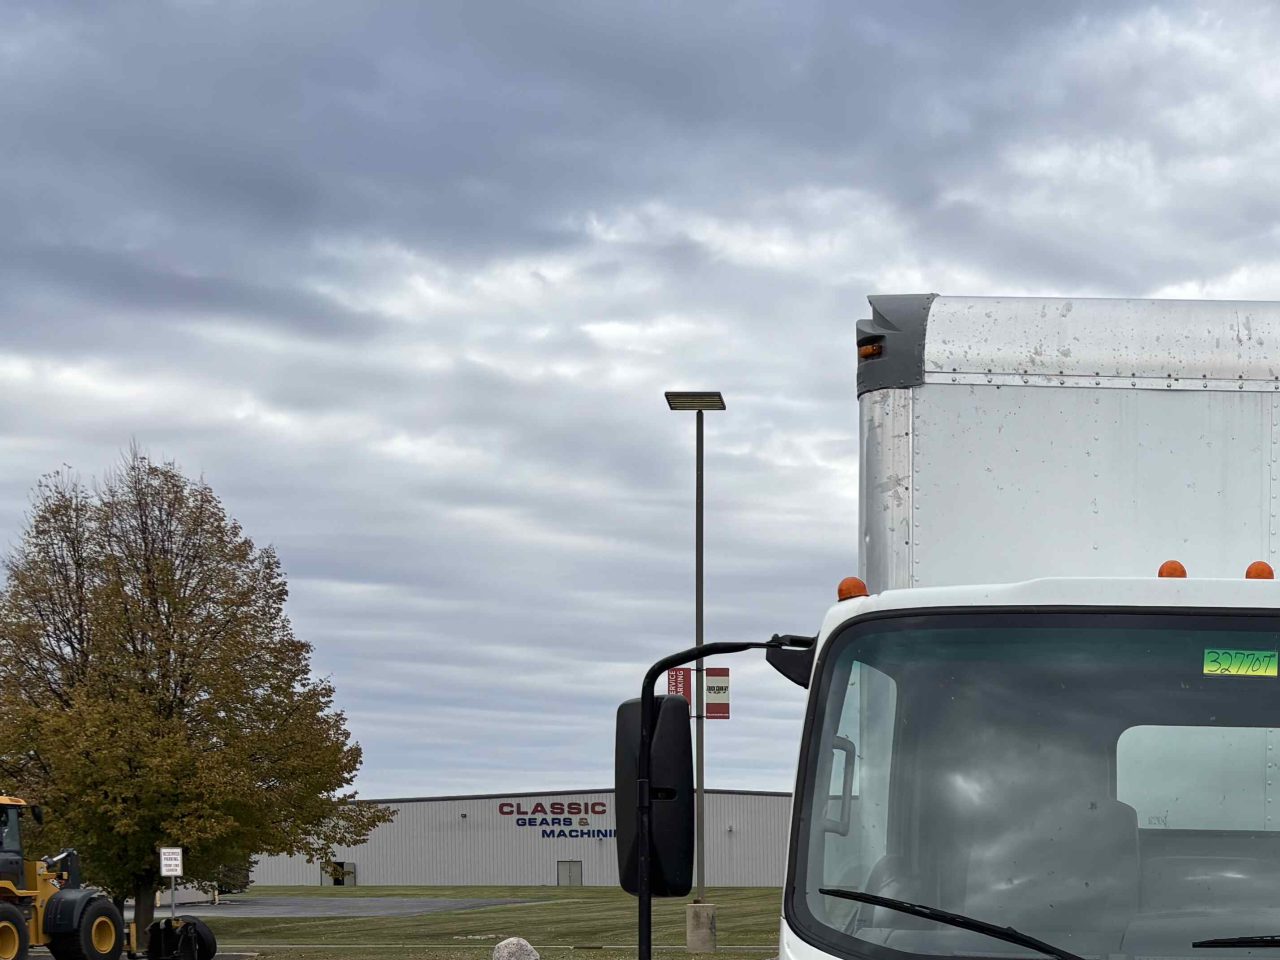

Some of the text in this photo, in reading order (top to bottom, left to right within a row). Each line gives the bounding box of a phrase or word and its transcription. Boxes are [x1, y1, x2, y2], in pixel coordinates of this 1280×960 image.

[498, 802, 607, 816] CLASSIC
[516, 818, 590, 827] GEARS &
[541, 829, 617, 839] MACHINI
